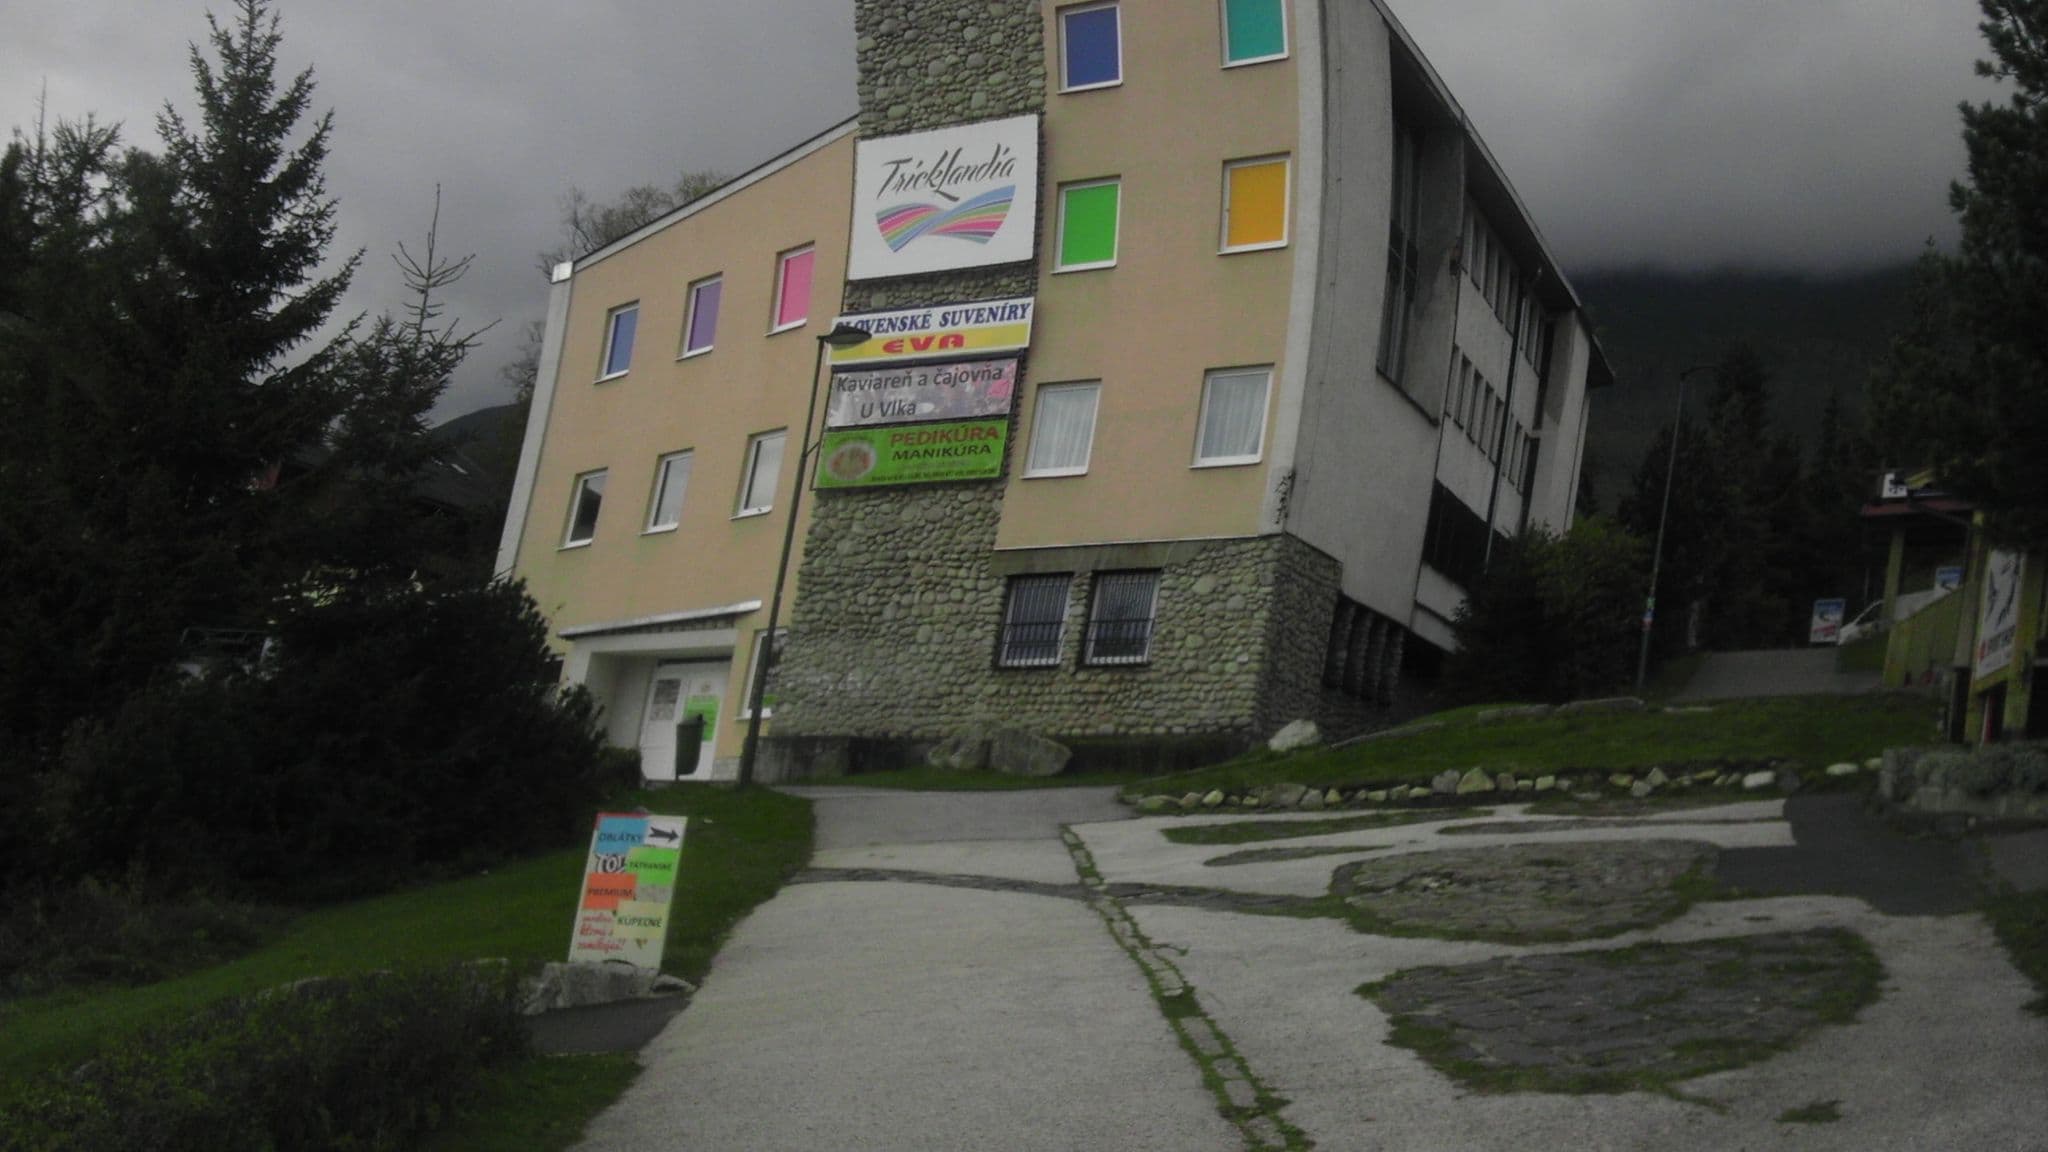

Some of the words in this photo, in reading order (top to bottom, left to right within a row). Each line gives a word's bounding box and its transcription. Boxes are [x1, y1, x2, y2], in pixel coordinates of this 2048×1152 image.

[836, 311, 932, 335] OVENSKÉ
[939, 302, 1031, 327] SUVENÍRY
[882, 333, 966, 354] EVA
[836, 370, 912, 392] Kaviareň
[917, 373, 929, 387] a
[932, 363, 1002, 389] čajovňa
[860, 404, 874, 418] U
[879, 400, 917, 417] Vlka
[890, 424, 1000, 448] PEDIKÚRA
